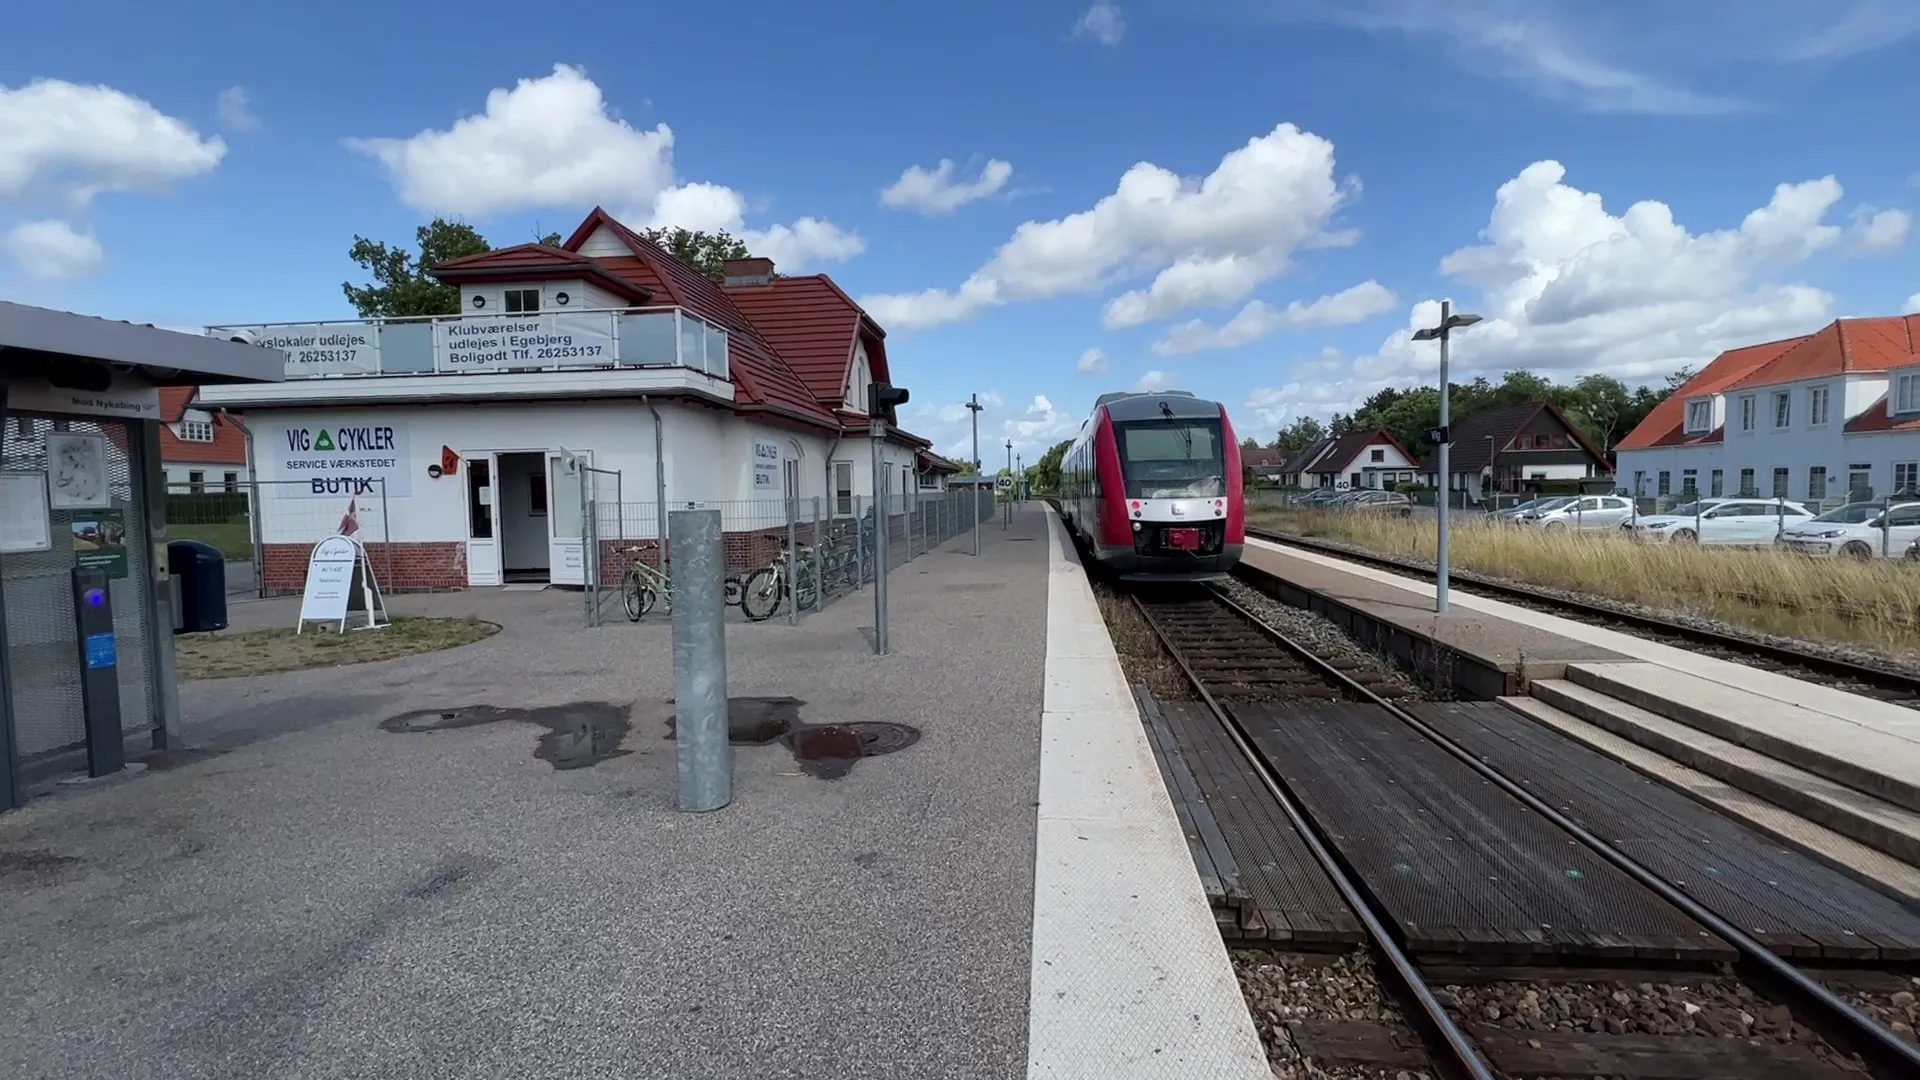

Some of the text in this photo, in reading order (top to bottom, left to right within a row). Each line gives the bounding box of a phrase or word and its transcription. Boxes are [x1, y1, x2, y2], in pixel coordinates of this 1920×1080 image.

[449, 323, 540, 336] Klubværelser
[319, 334, 365, 348] udlejes
[449, 334, 572, 350] udlejes i Egebjerg
[284, 350, 357, 363] lf. 26253137
[450, 346, 602, 364] Boligodt Tlf. 26253137
[287, 427, 395, 451] VIG CYKLER
[286, 458, 396, 469] SERVICE VÆRKSTEDET
[312, 477, 374, 494] BUTIK
[998, 479, 1012, 487] 40
[1336, 481, 1349, 490] 40
